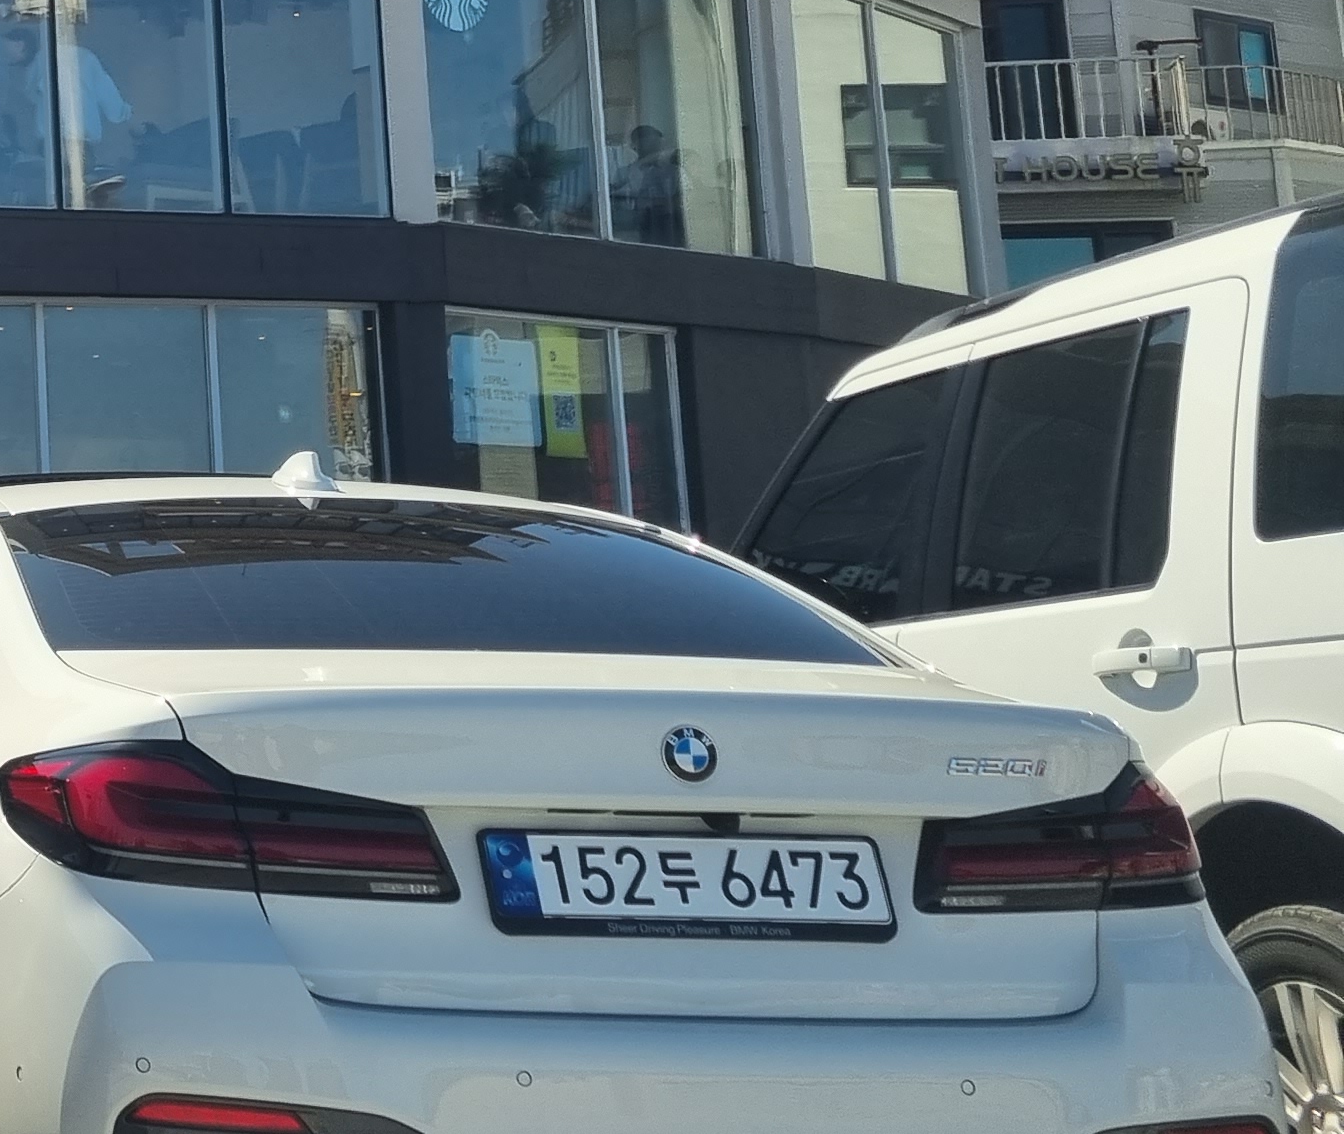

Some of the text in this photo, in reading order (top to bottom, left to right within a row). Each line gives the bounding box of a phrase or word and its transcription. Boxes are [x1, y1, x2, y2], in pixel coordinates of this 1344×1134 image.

[1022, 153, 1160, 183] HOUSE
[541, 845, 870, 910] 152두 6473
[608, 922, 791, 936] Sheer Driving Pleasure BMW Korea
